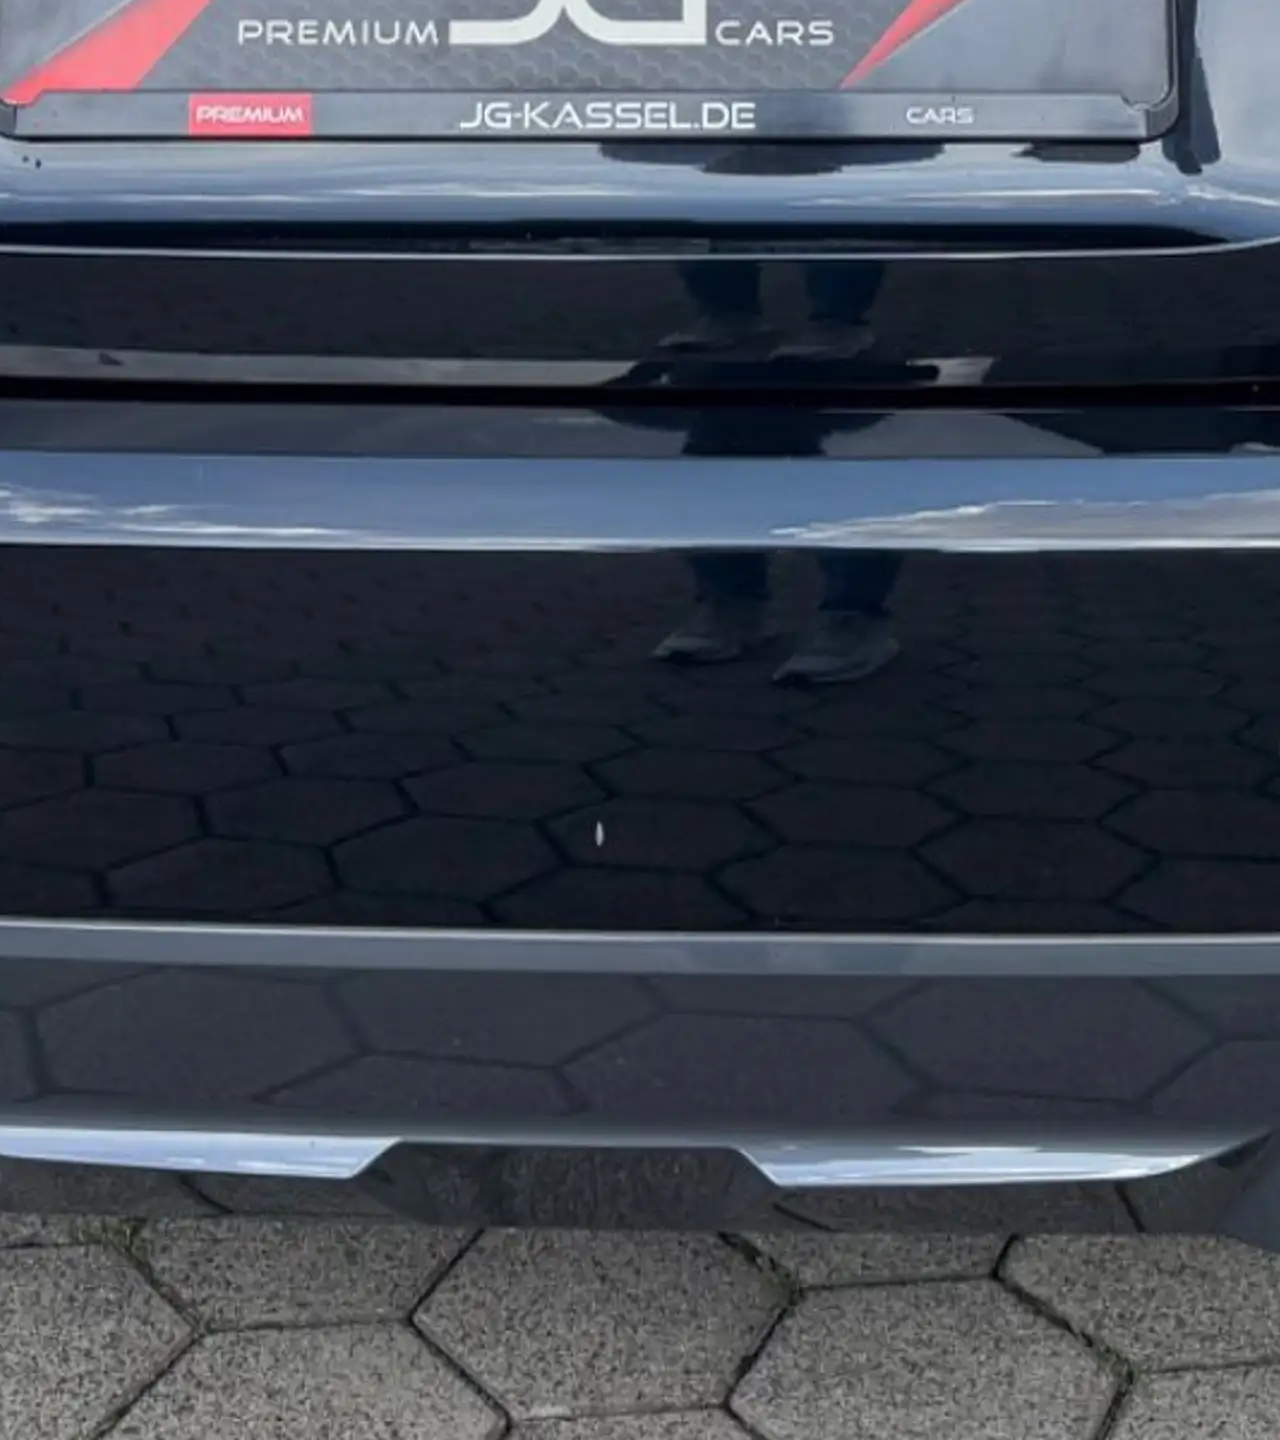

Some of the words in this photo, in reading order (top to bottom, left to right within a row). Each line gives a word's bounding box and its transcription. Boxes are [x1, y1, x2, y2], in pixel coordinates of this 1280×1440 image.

[237, 19, 439, 46] PREMIUM
[715, 20, 834, 46] CARS
[195, 105, 304, 124] PREMIUM
[459, 101, 756, 130] JG-KASSEL.DE
[906, 107, 974, 124] CARS
